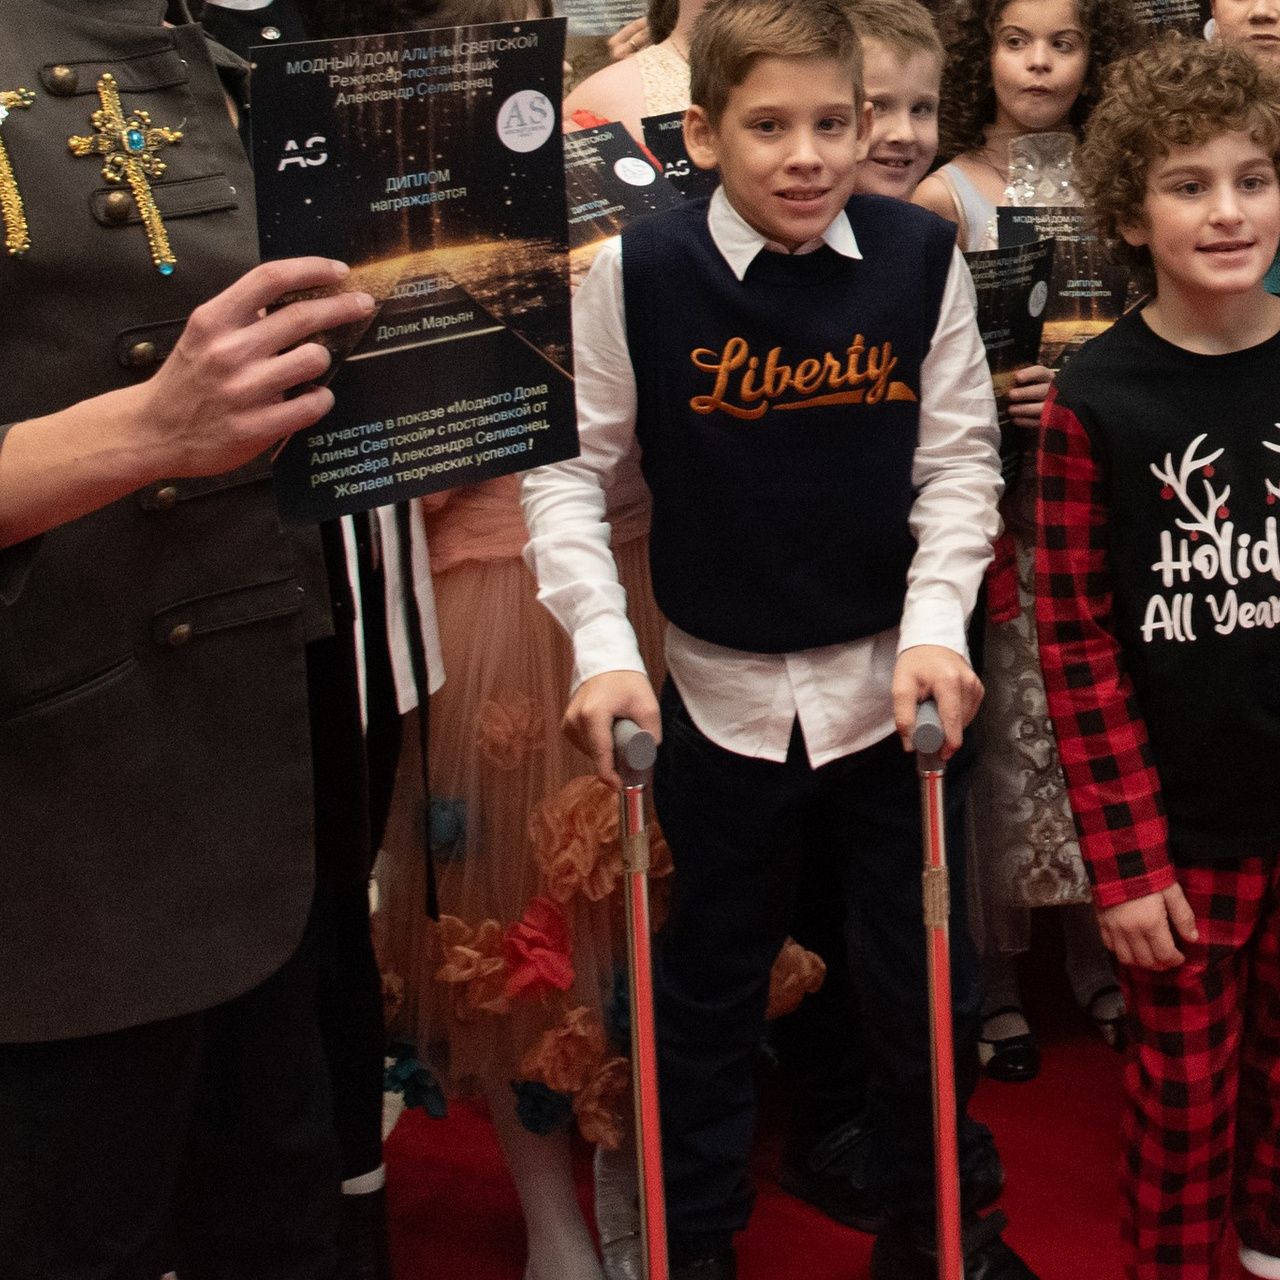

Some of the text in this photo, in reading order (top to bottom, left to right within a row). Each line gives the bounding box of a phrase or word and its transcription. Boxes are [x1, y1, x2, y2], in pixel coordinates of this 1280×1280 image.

[286, 33, 538, 75] МОДНЫЙ ДОМ АЛИНЫ СВЕТСКОЙ
[336, 78, 493, 106] Александр Селивонец
[504, 96, 547, 128] AS
[279, 136, 328, 171] AS
[386, 169, 450, 193] ДИПЛОМ
[371, 186, 467, 212] награждается
[376, 310, 474, 342] Долик Марьян
[690, 334, 897, 420] Liberty
[308, 435, 325, 448] за
[326, 421, 383, 444] участие
[386, 418, 394, 429] в
[397, 407, 445, 427] показе
[514, 383, 548, 403] Дома
[311, 448, 358, 466] Алины
[438, 424, 446, 435] с
[448, 402, 531, 433] постановкой
[533, 401, 548, 413] от
[392, 438, 473, 466] Александра
[334, 475, 393, 499] Желаем
[396, 456, 473, 483] творческих
[1140, 592, 1197, 642] All
